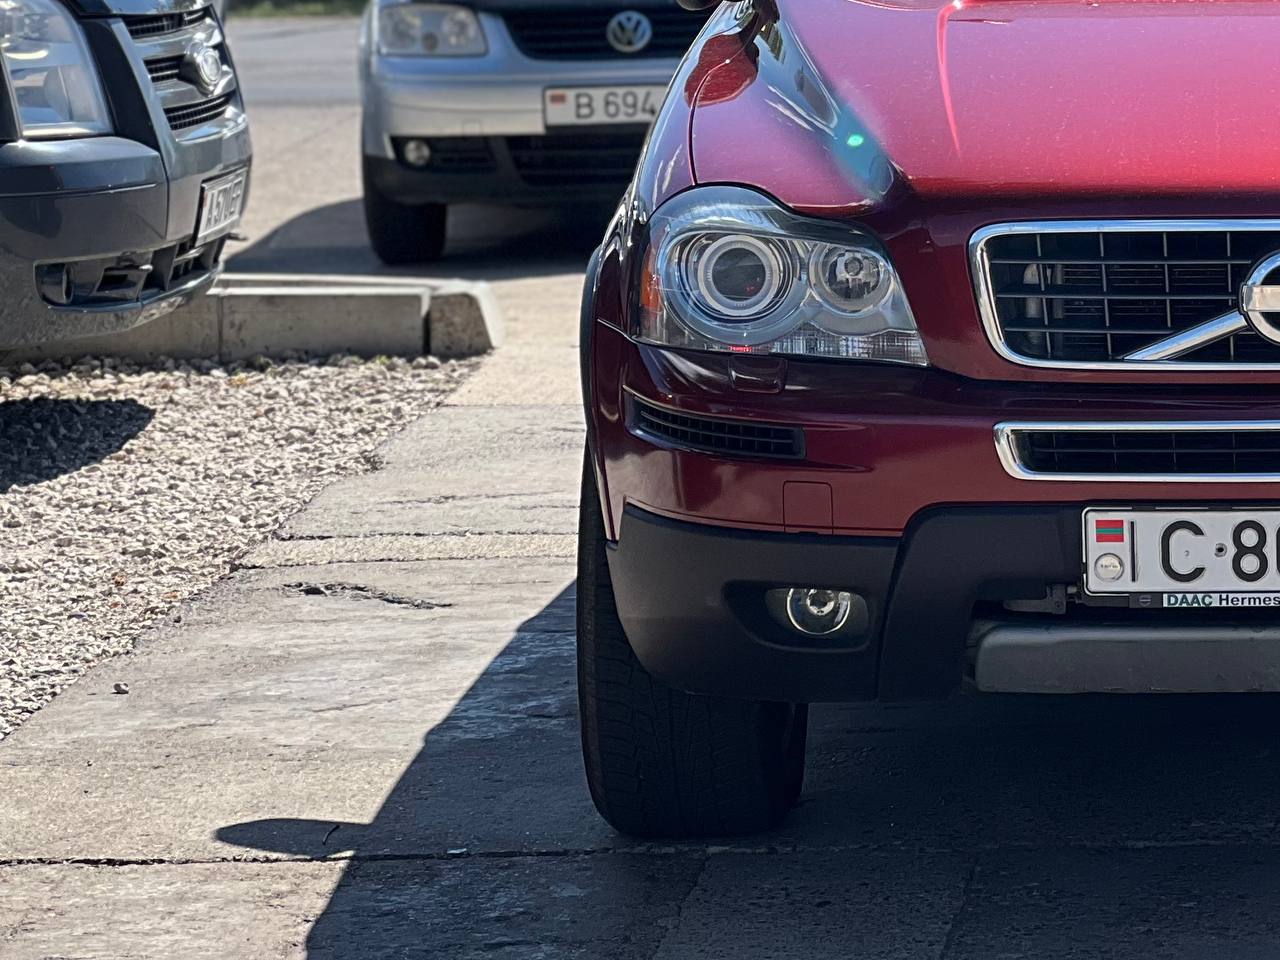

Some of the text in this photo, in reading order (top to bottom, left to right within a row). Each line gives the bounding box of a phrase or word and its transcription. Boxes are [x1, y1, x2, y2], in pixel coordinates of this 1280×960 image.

[575, 90, 656, 119] B 694
[1161, 520, 1206, 582] C
[1166, 593, 1280, 606] DAAC Hermes
